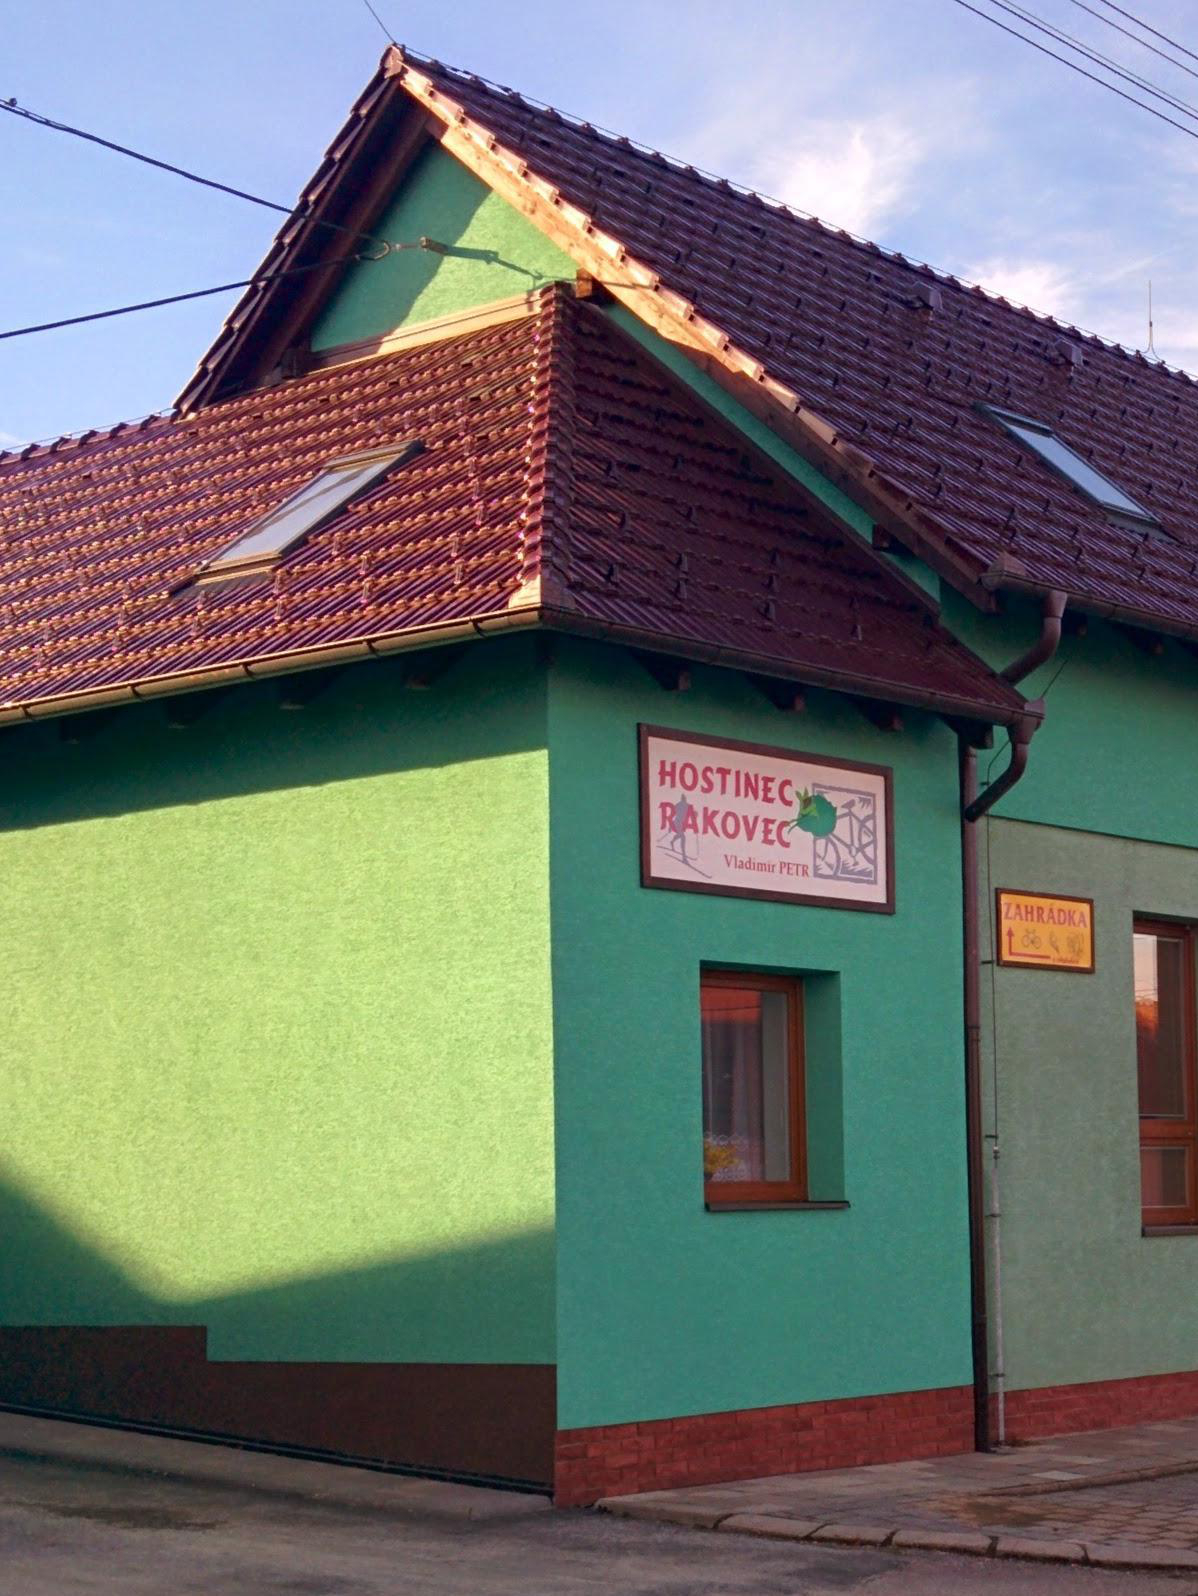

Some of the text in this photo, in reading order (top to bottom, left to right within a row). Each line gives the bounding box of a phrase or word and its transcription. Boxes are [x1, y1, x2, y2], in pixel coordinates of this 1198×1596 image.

[658, 759, 794, 807] HOSTINEC
[658, 802, 791, 848] RAKOVEC
[779, 861, 809, 877] PETR
